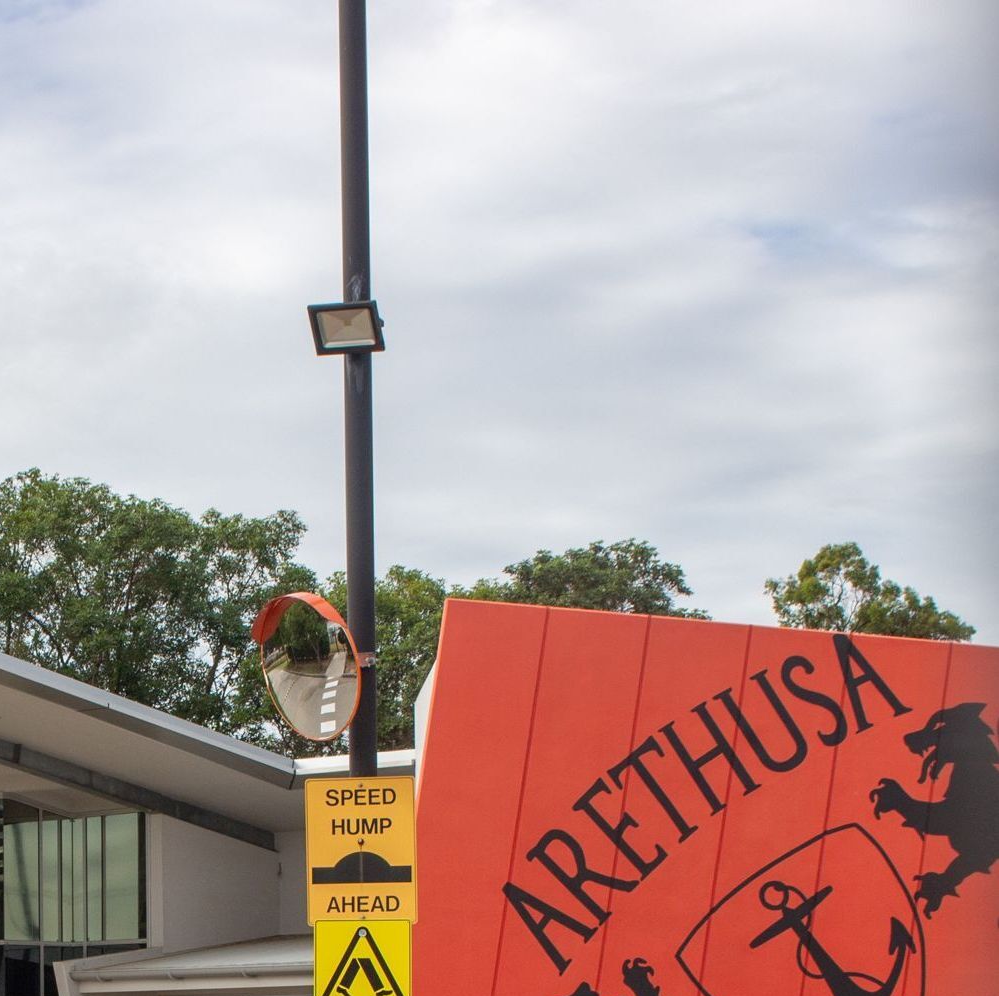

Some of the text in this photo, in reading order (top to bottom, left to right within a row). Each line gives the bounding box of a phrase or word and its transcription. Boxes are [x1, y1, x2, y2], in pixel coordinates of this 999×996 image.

[325, 788, 397, 806] SPEED
[503, 634, 912, 975] ARETHUSA
[331, 818, 393, 835] HUMP
[326, 895, 400, 913] AHEAD
